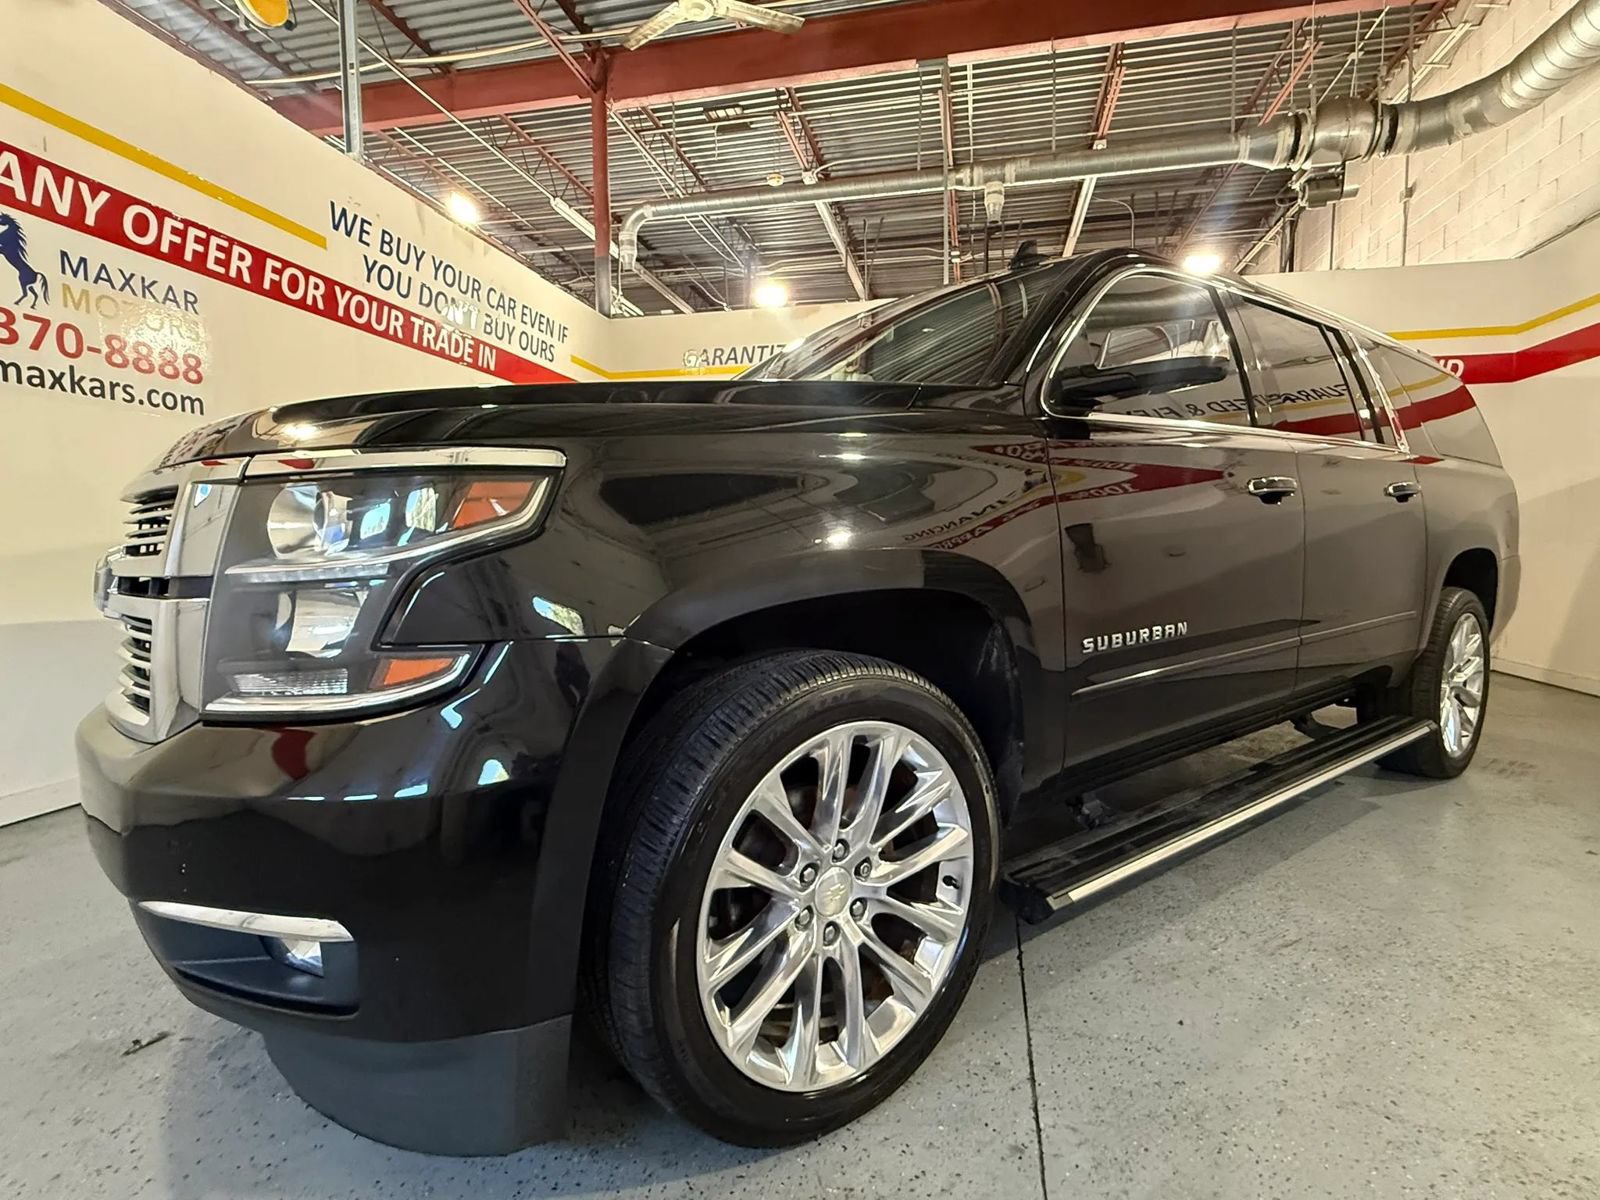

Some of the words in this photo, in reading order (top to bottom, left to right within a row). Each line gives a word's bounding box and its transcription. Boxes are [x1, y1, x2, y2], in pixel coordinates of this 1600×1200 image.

[0, 151, 111, 227] ANY
[122, 204, 253, 284] OFFER
[263, 257, 326, 310] FOR
[333, 285, 404, 340] YOUR
[410, 316, 475, 363] TRADE
[478, 343, 497, 372] IN
[59, 249, 200, 315] MAXKAR
[329, 200, 373, 247] WE
[379, 229, 426, 272] BUY
[431, 255, 483, 303] YOUR
[487, 286, 517, 320] CAR
[521, 303, 556, 340] EVEN
[558, 323, 569, 344] IF
[61, 281, 201, 342] MOORS
[362, 253, 412, 300] YOU
[483, 312, 516, 345] BUY
[518, 330, 556, 363] OURS
[1082, 621, 1188, 653] SUBURBAN
